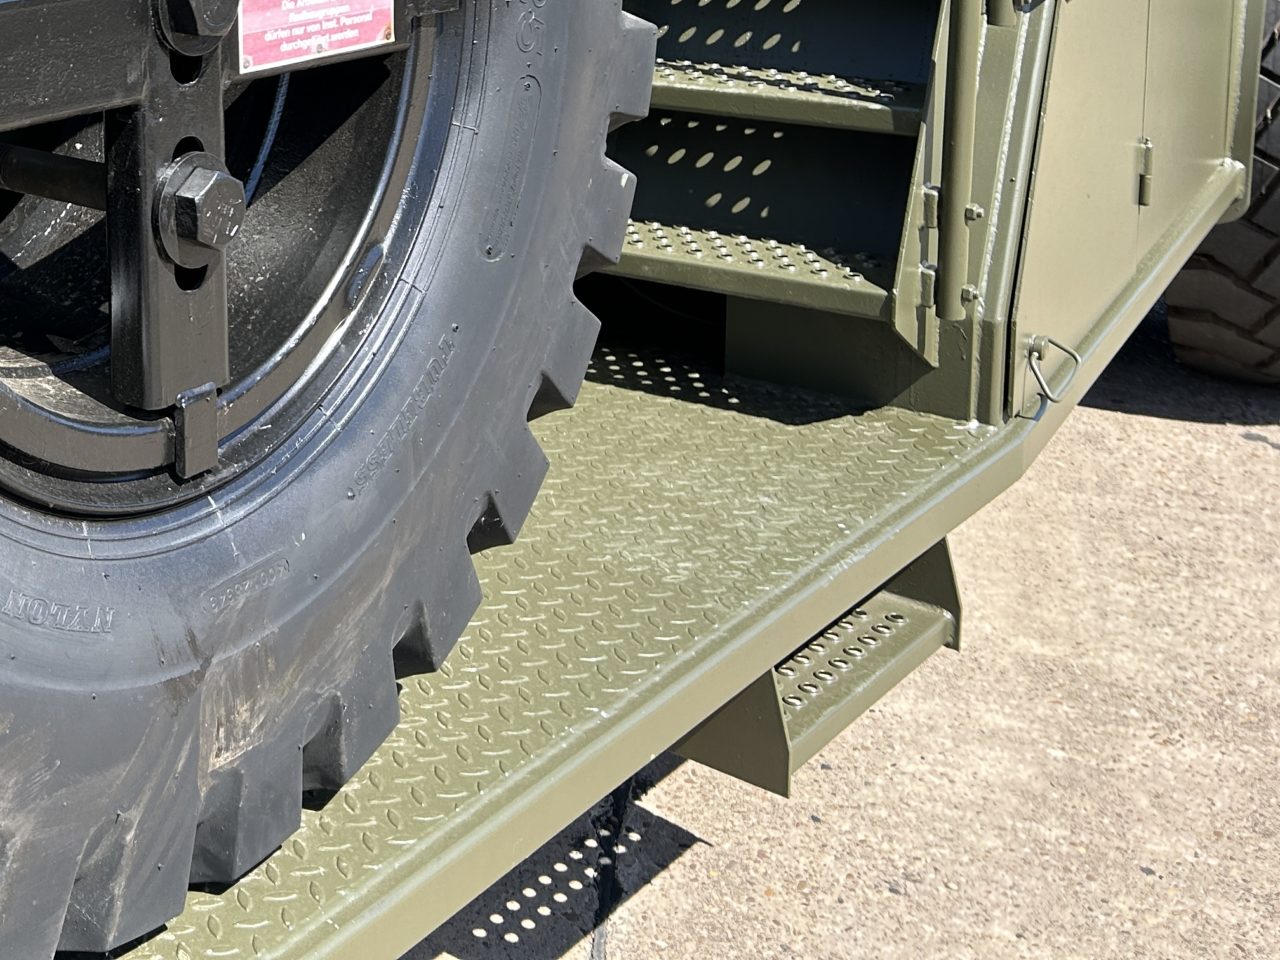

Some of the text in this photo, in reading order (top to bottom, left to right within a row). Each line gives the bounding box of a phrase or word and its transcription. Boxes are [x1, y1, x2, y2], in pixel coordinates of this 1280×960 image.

[281, 0, 295, 10] Die
[264, 28, 290, 41] dürfen
[291, 25, 305, 36] nur
[306, 22, 321, 33] von
[330, 28, 359, 41] werden
[1, 588, 116, 634] NYLON
